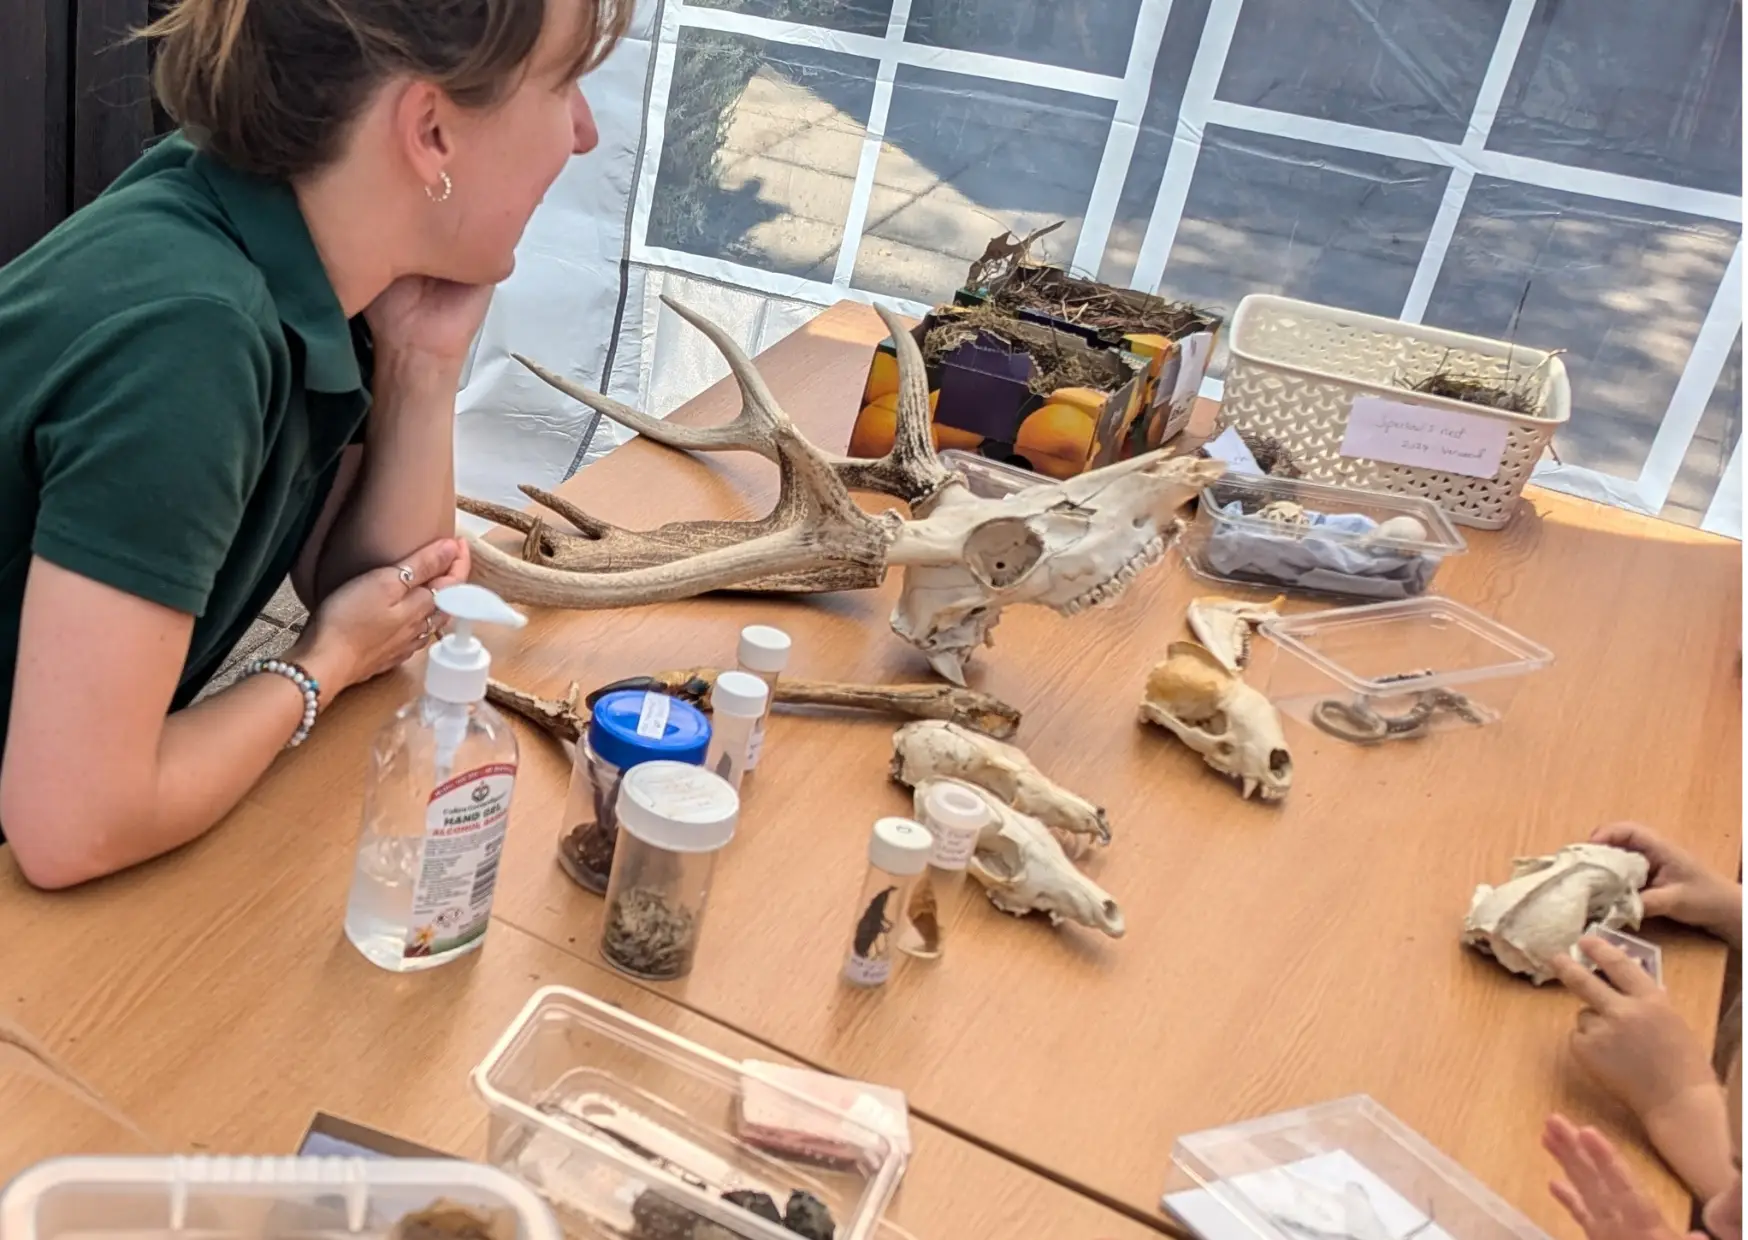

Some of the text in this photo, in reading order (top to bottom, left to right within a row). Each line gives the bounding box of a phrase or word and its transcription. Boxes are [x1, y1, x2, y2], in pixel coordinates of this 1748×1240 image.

[444, 803, 501, 826] HAND GEL
[432, 822, 481, 836] ALCOHOL
